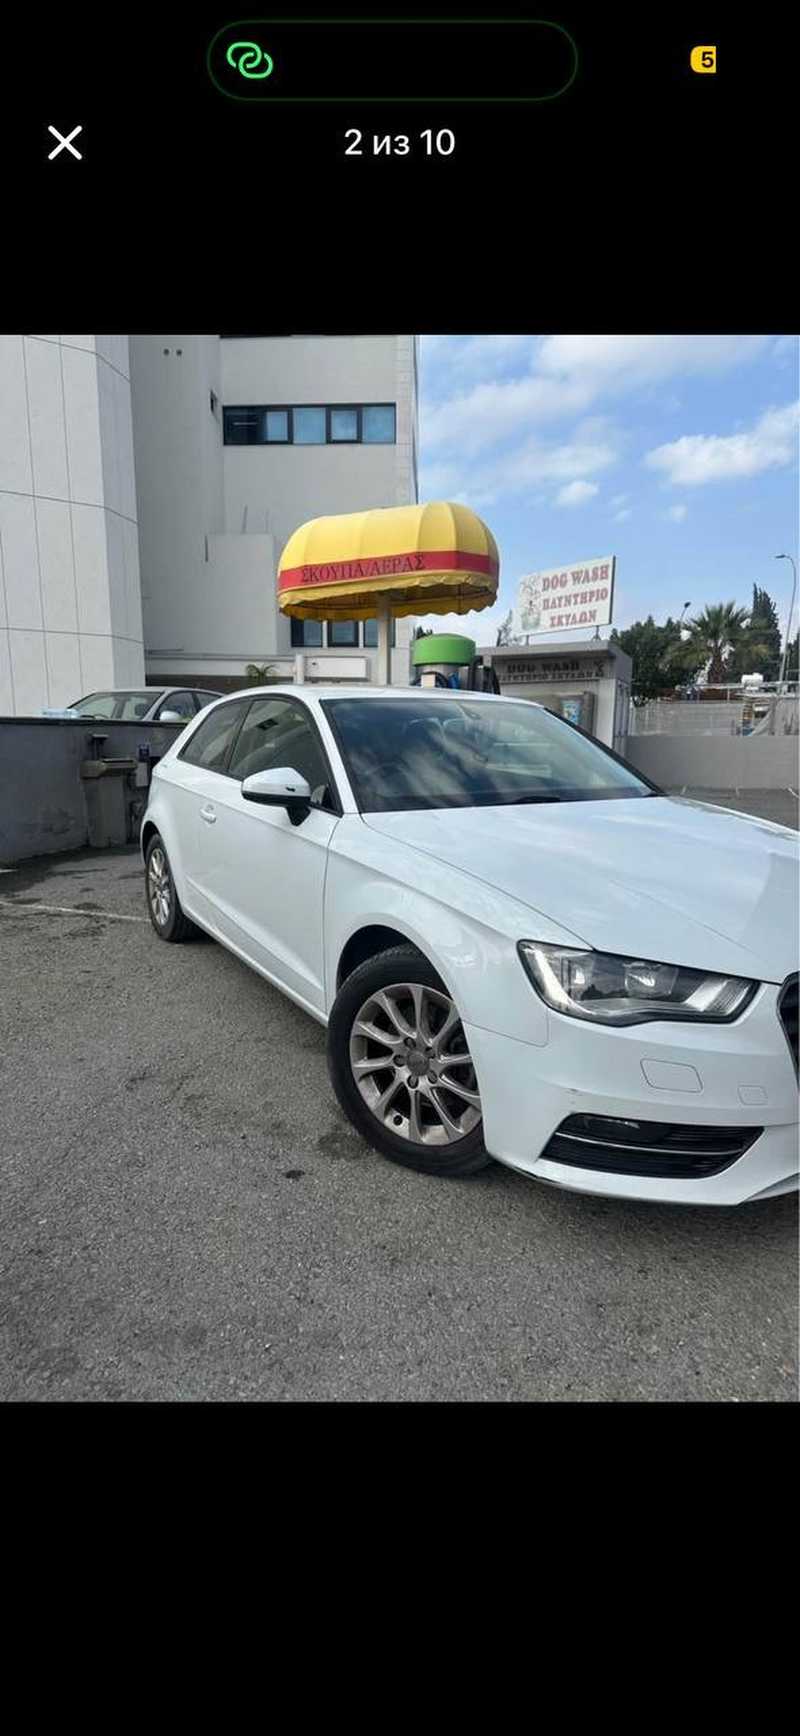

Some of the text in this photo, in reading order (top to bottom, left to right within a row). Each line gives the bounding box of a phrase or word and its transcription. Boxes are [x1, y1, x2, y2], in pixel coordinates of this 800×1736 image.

[302, 553, 426, 584] ΣΚΟΥΠΑ/ΑΕΡΑΣ
[542, 564, 609, 591] DOG WASH
[542, 588, 608, 610] ΠΛΥΝΤΗΡΙΟ
